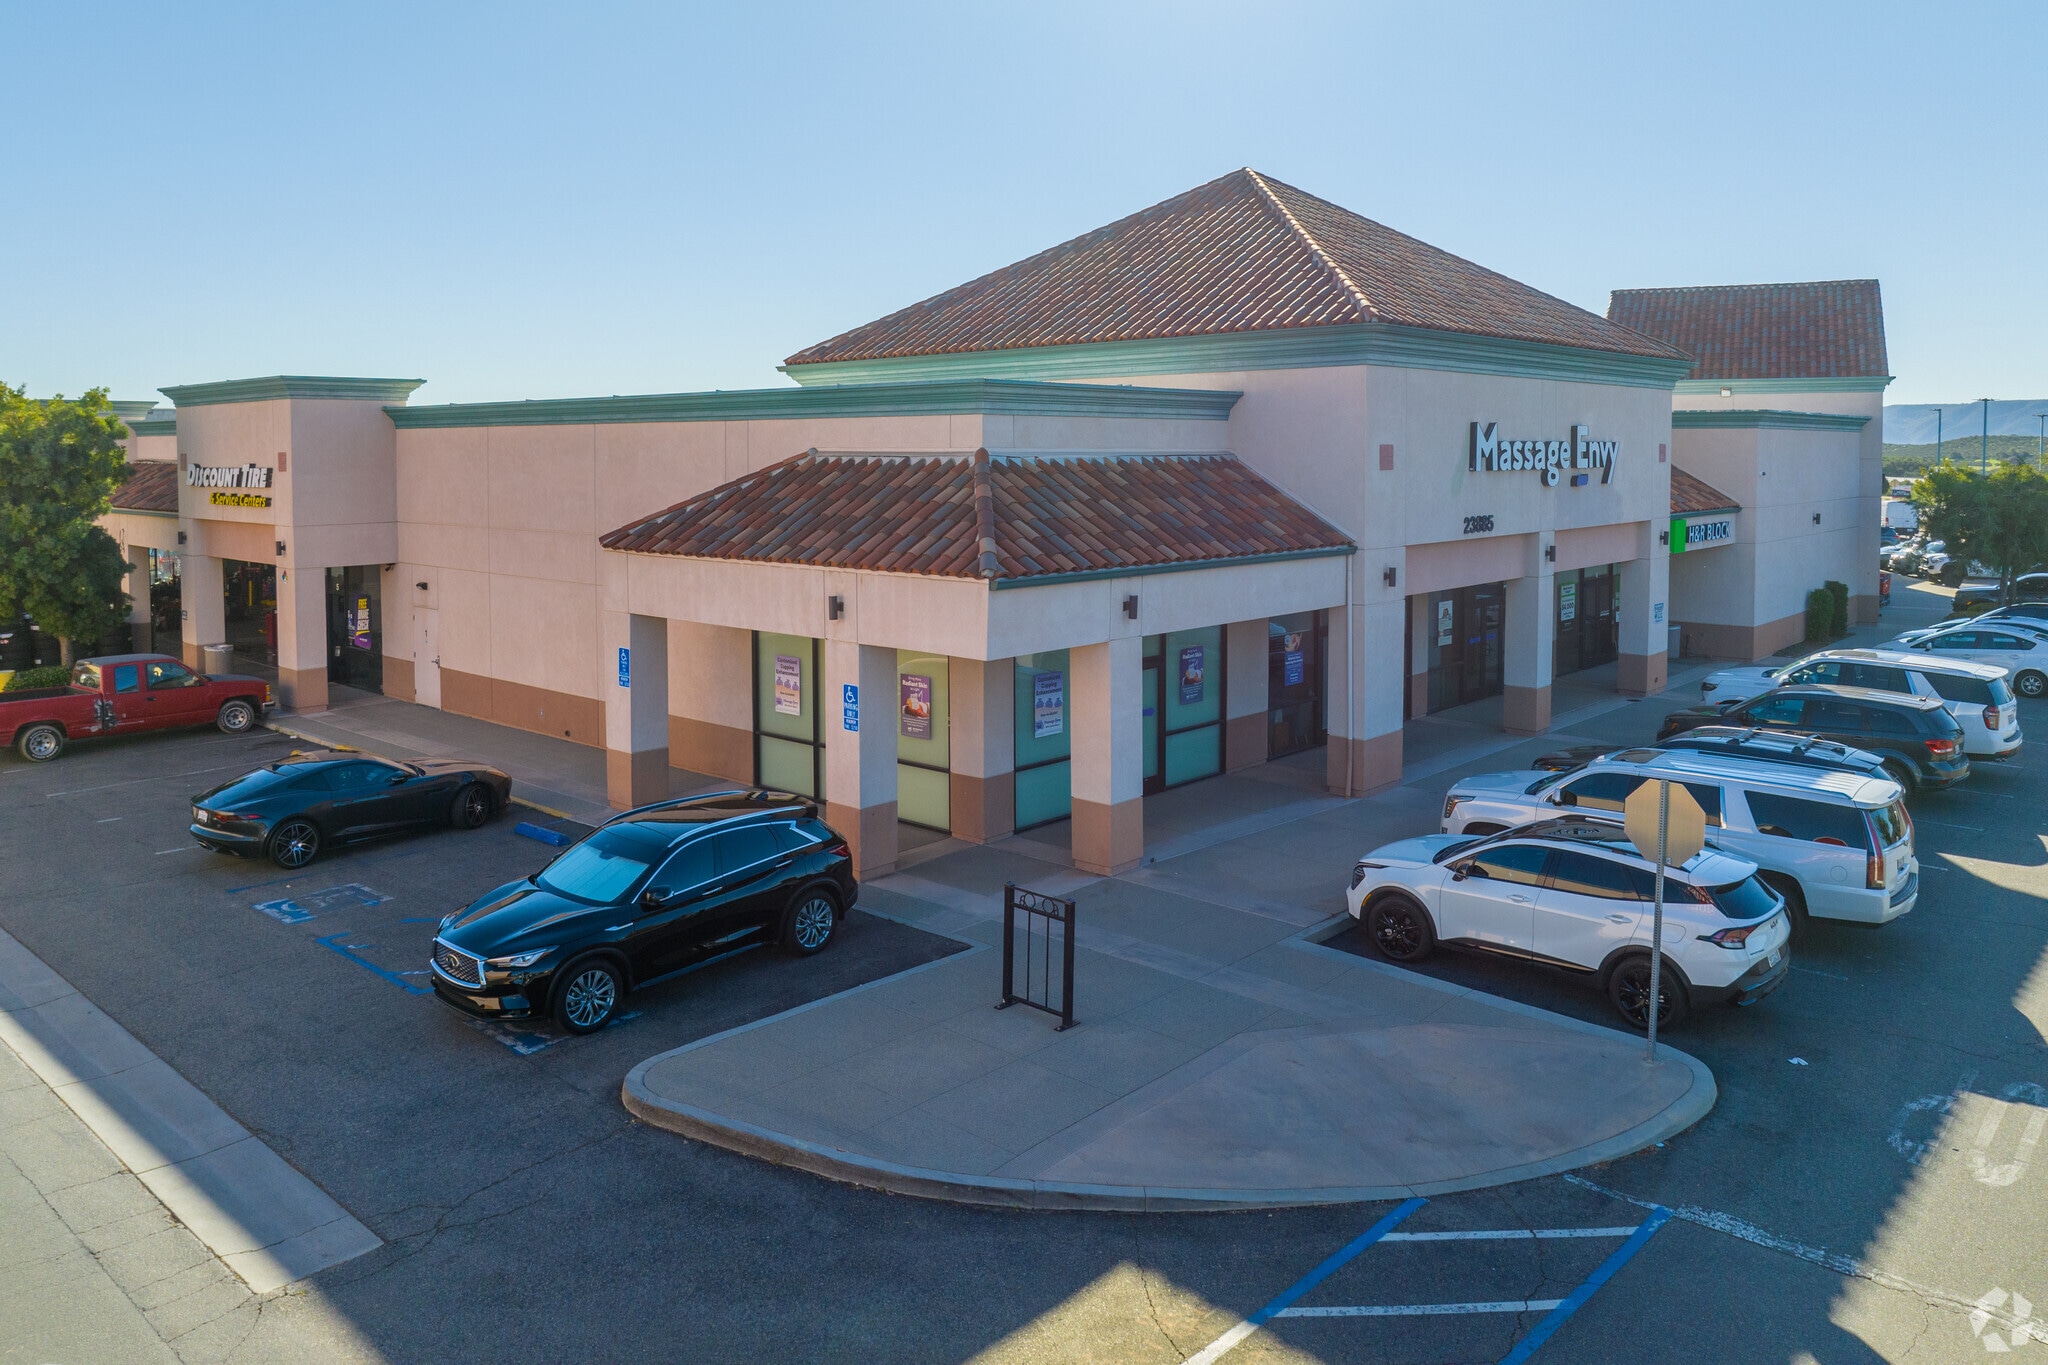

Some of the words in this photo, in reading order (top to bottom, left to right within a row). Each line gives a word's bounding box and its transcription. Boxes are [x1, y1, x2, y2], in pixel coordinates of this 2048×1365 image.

[1470, 422, 1571, 487] Massage
[1571, 425, 1620, 484] Envy
[241, 463, 269, 489] TIRE
[215, 493, 239, 507] Service
[240, 494, 267, 508] Centers
[1688, 524, 1706, 543] H&R
[1707, 520, 1731, 541] BLOCK
